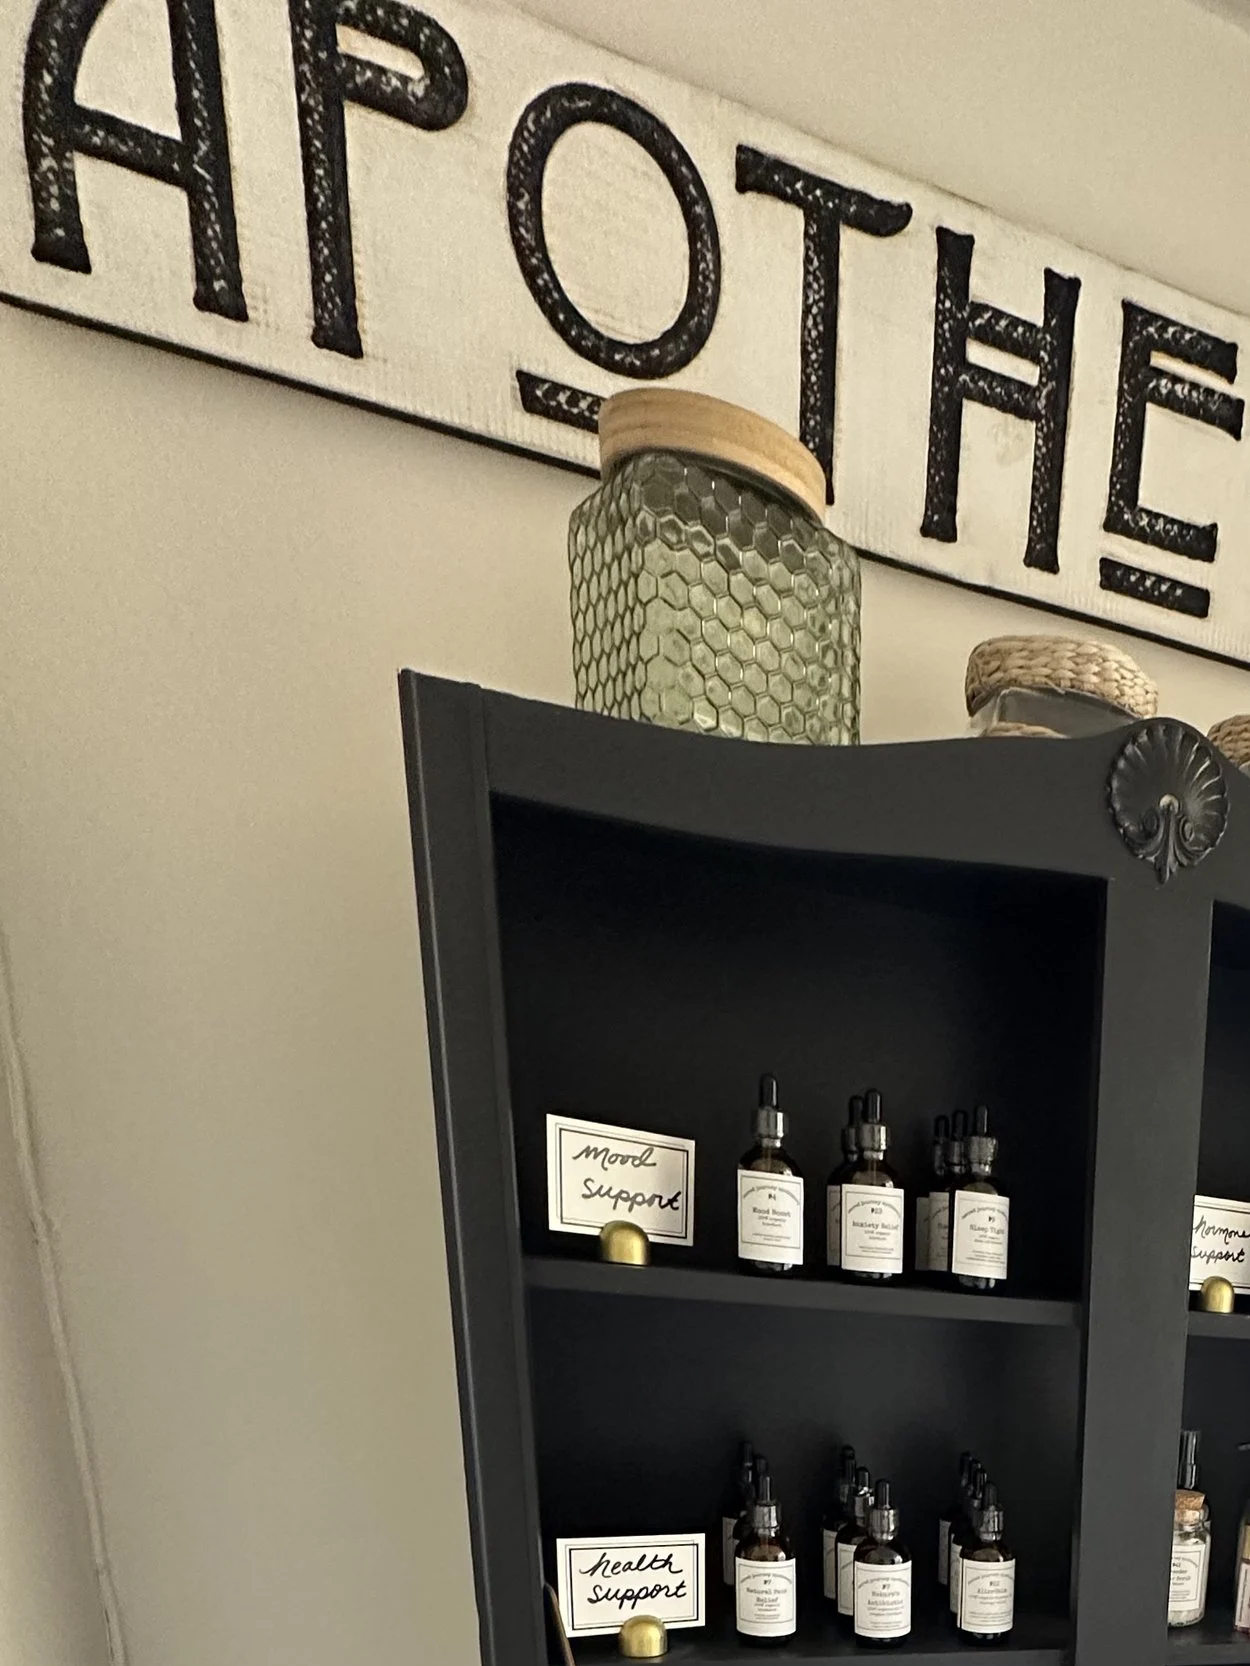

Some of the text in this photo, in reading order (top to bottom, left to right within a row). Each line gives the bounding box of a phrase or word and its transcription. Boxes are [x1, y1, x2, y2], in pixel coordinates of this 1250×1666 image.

[852, 1220, 879, 1229] Anxiety
[579, 1552, 684, 1579] health
[587, 1580, 688, 1610] support
